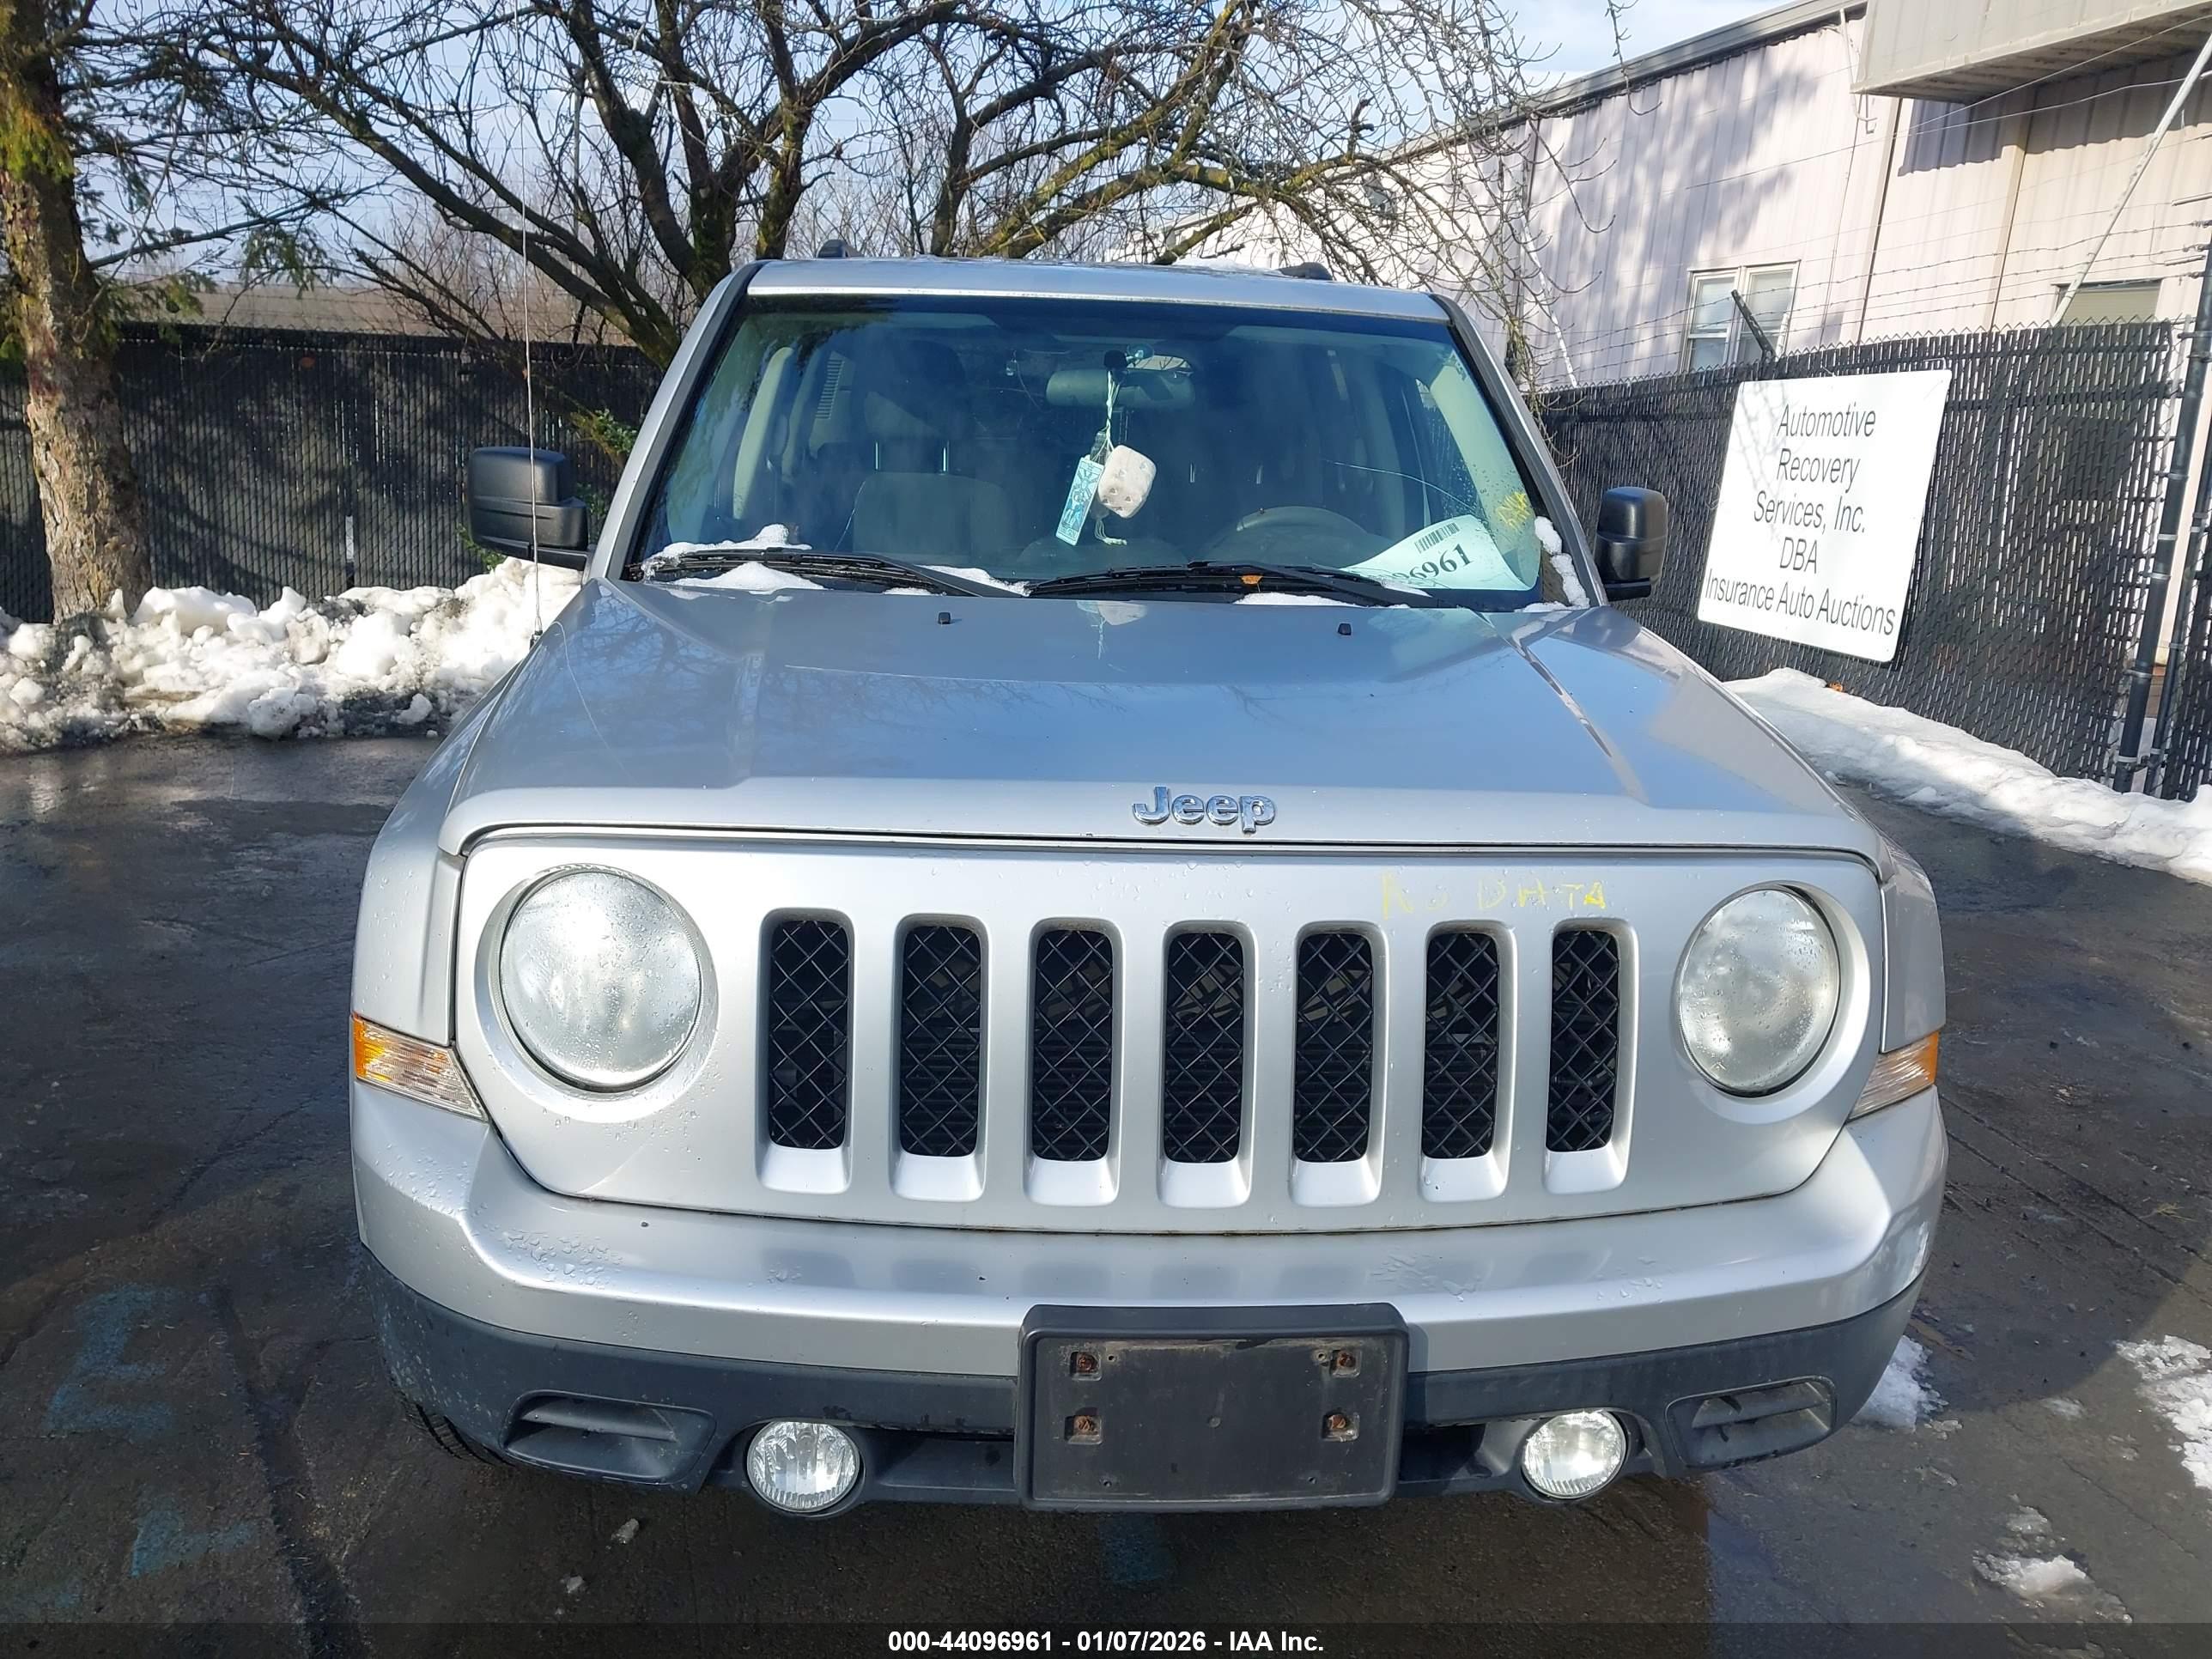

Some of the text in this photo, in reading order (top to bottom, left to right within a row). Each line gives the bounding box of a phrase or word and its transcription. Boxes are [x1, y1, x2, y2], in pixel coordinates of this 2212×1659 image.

[1777, 402, 1876, 437] Automotive
[1777, 448, 1861, 494] Recovery
[1753, 490, 1866, 535] Services, Inc.
[1779, 537, 1818, 574] DBA
[1705, 568, 1896, 636] Insurance Auto Auctions
[1133, 787, 1276, 834] Jeep
